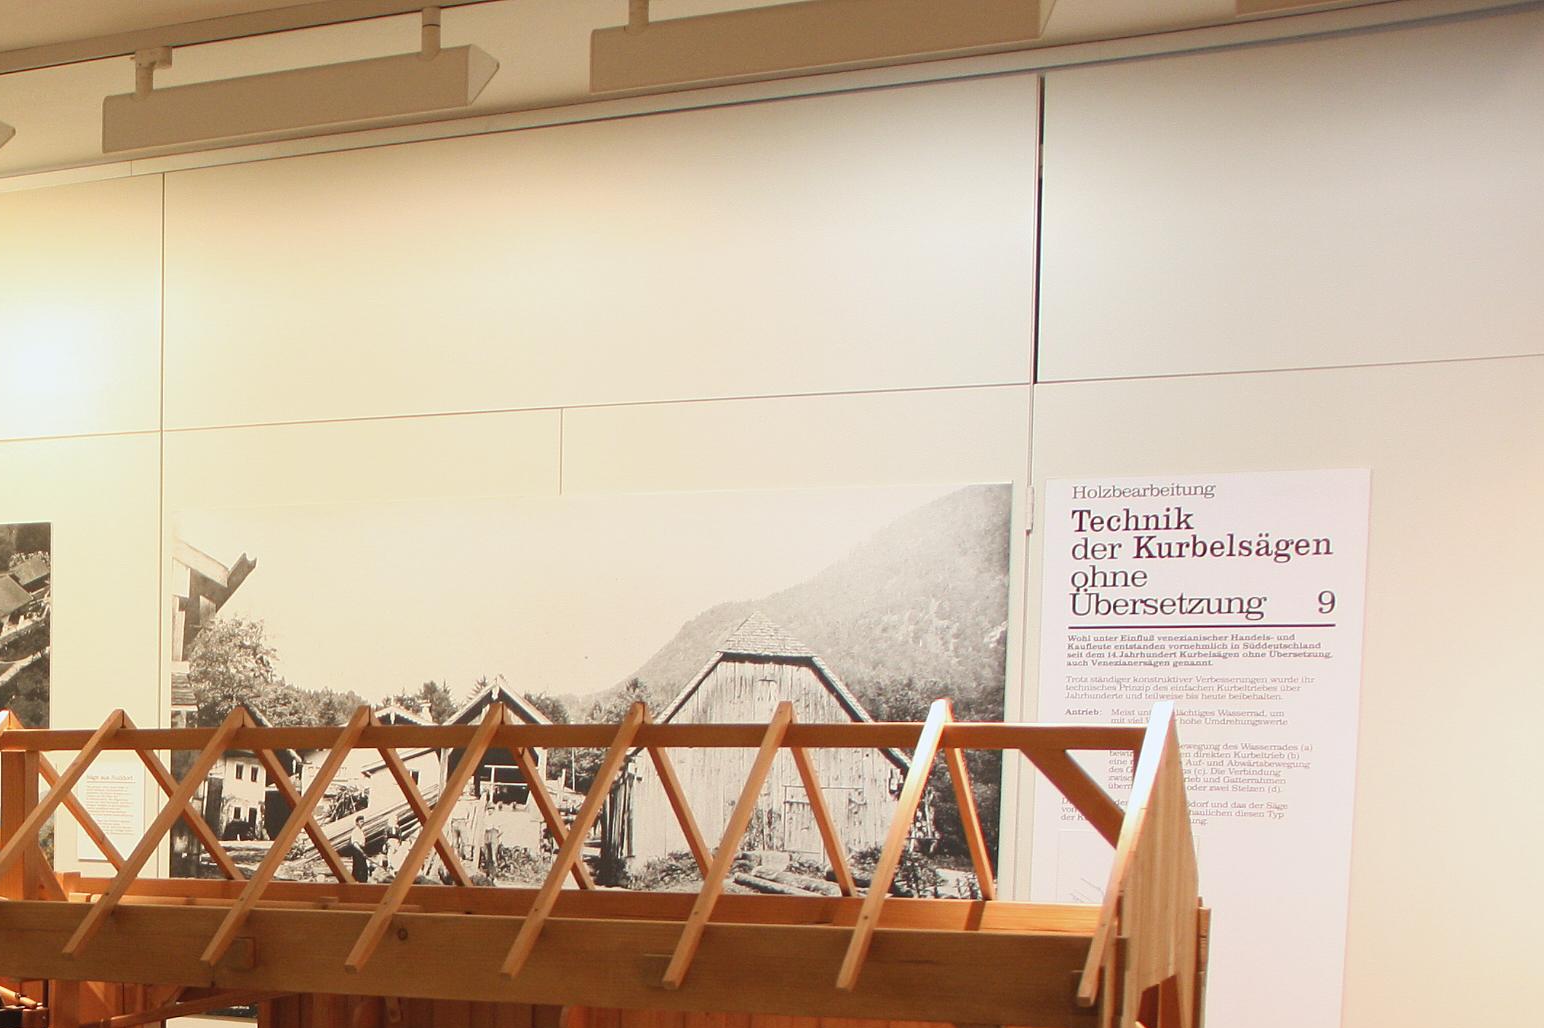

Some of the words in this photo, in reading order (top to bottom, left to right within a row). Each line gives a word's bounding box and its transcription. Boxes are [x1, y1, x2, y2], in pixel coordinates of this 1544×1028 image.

[1072, 483, 1216, 499] Holzbearbeitung
[1072, 507, 1194, 532] Technik
[1072, 537, 1122, 560] der
[1132, 533, 1333, 563] Kurbelsägen
[1071, 565, 1147, 588] ohne
[1069, 588, 1267, 620] Übersetzung
[1318, 590, 1336, 614] 9
[1243, 641, 1321, 650] Süddeutschland
[1179, 651, 1240, 660] Kurbelsägen
[1091, 660, 1170, 668] Venezianersägen
[1119, 684, 1151, 693] Prinzip
